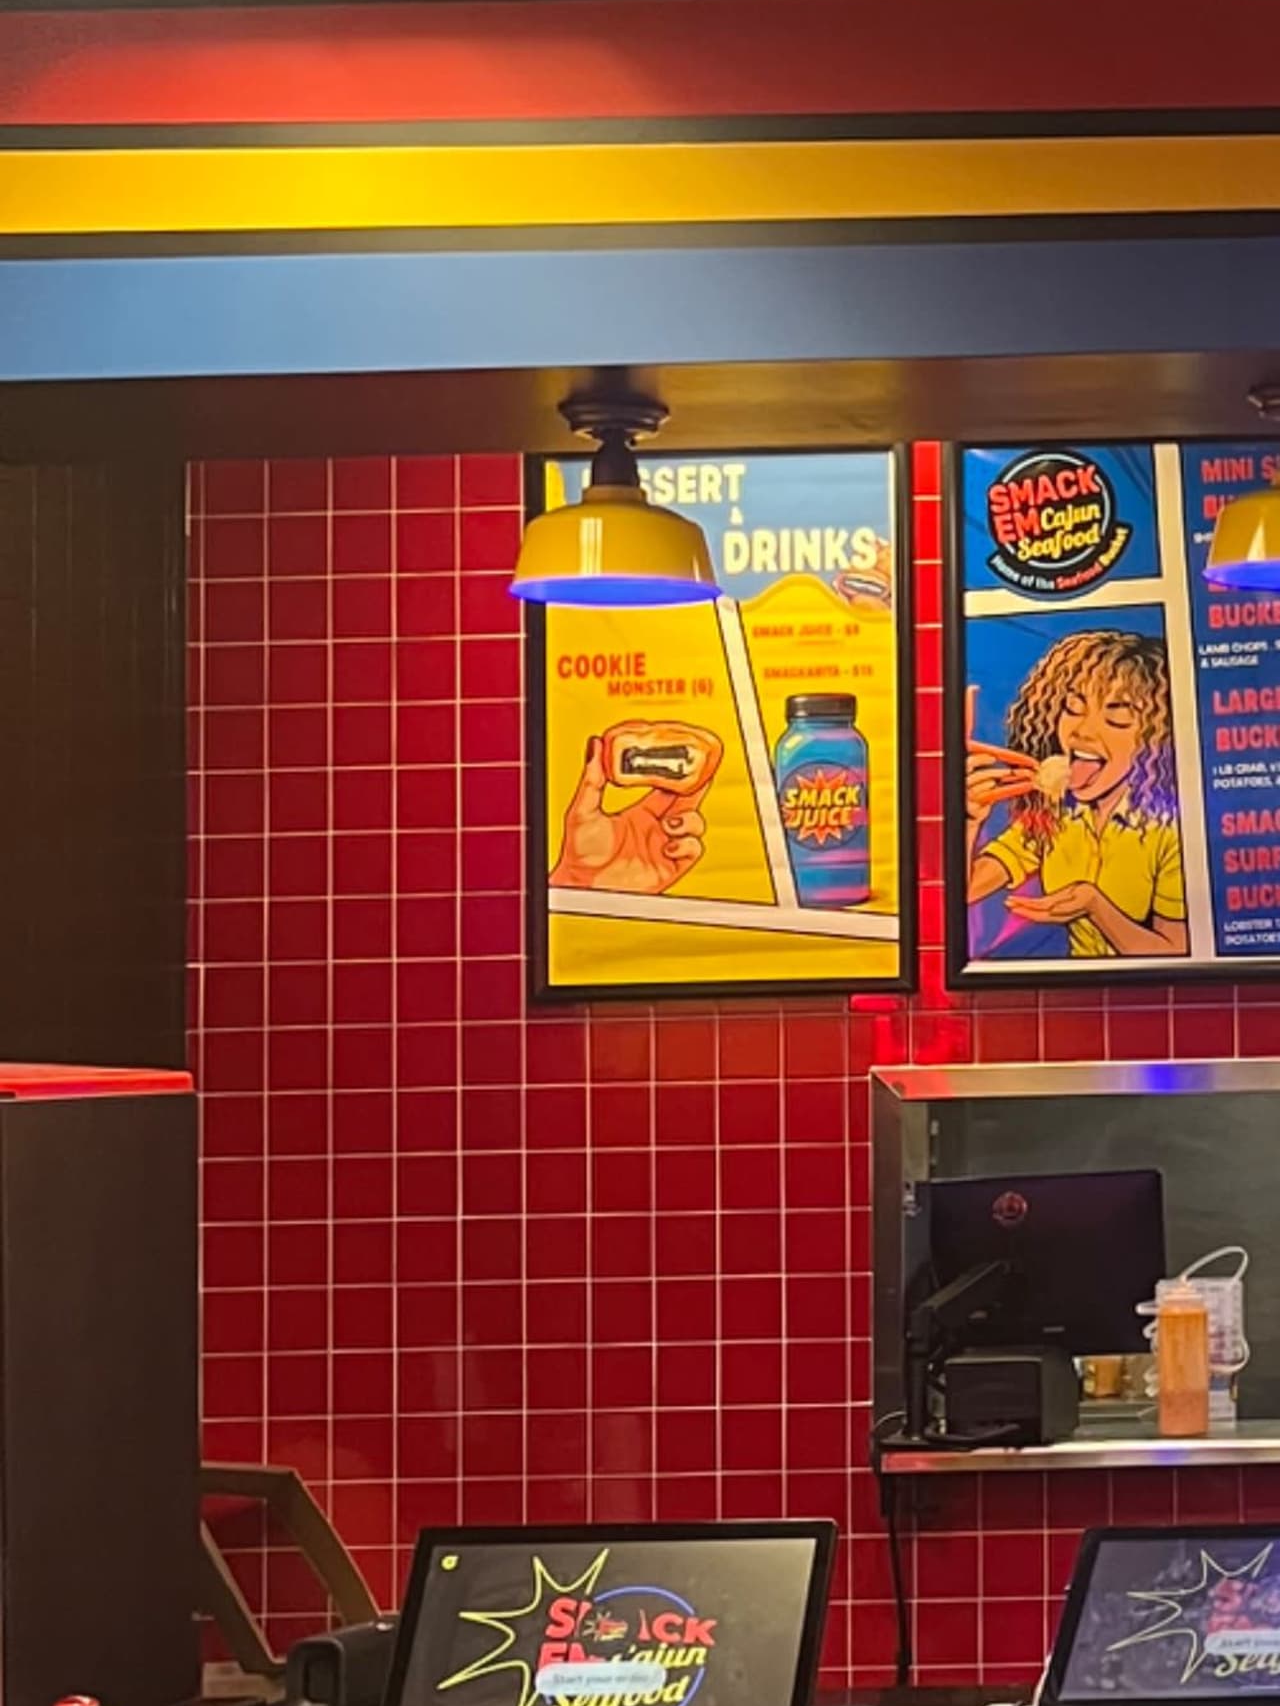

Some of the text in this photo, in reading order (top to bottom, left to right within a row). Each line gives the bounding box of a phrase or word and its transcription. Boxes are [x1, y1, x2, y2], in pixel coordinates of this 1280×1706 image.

[1202, 457, 1255, 483] MINI
[988, 465, 1100, 514] SMACK
[994, 503, 1100, 544] EM Cajun
[722, 527, 879, 575] DRINKS
[1017, 523, 1100, 561] Seafood
[557, 652, 647, 679] COOKIE
[607, 679, 687, 697] MONSTER
[784, 785, 861, 809] SMACK
[784, 806, 852, 829] JUICE
